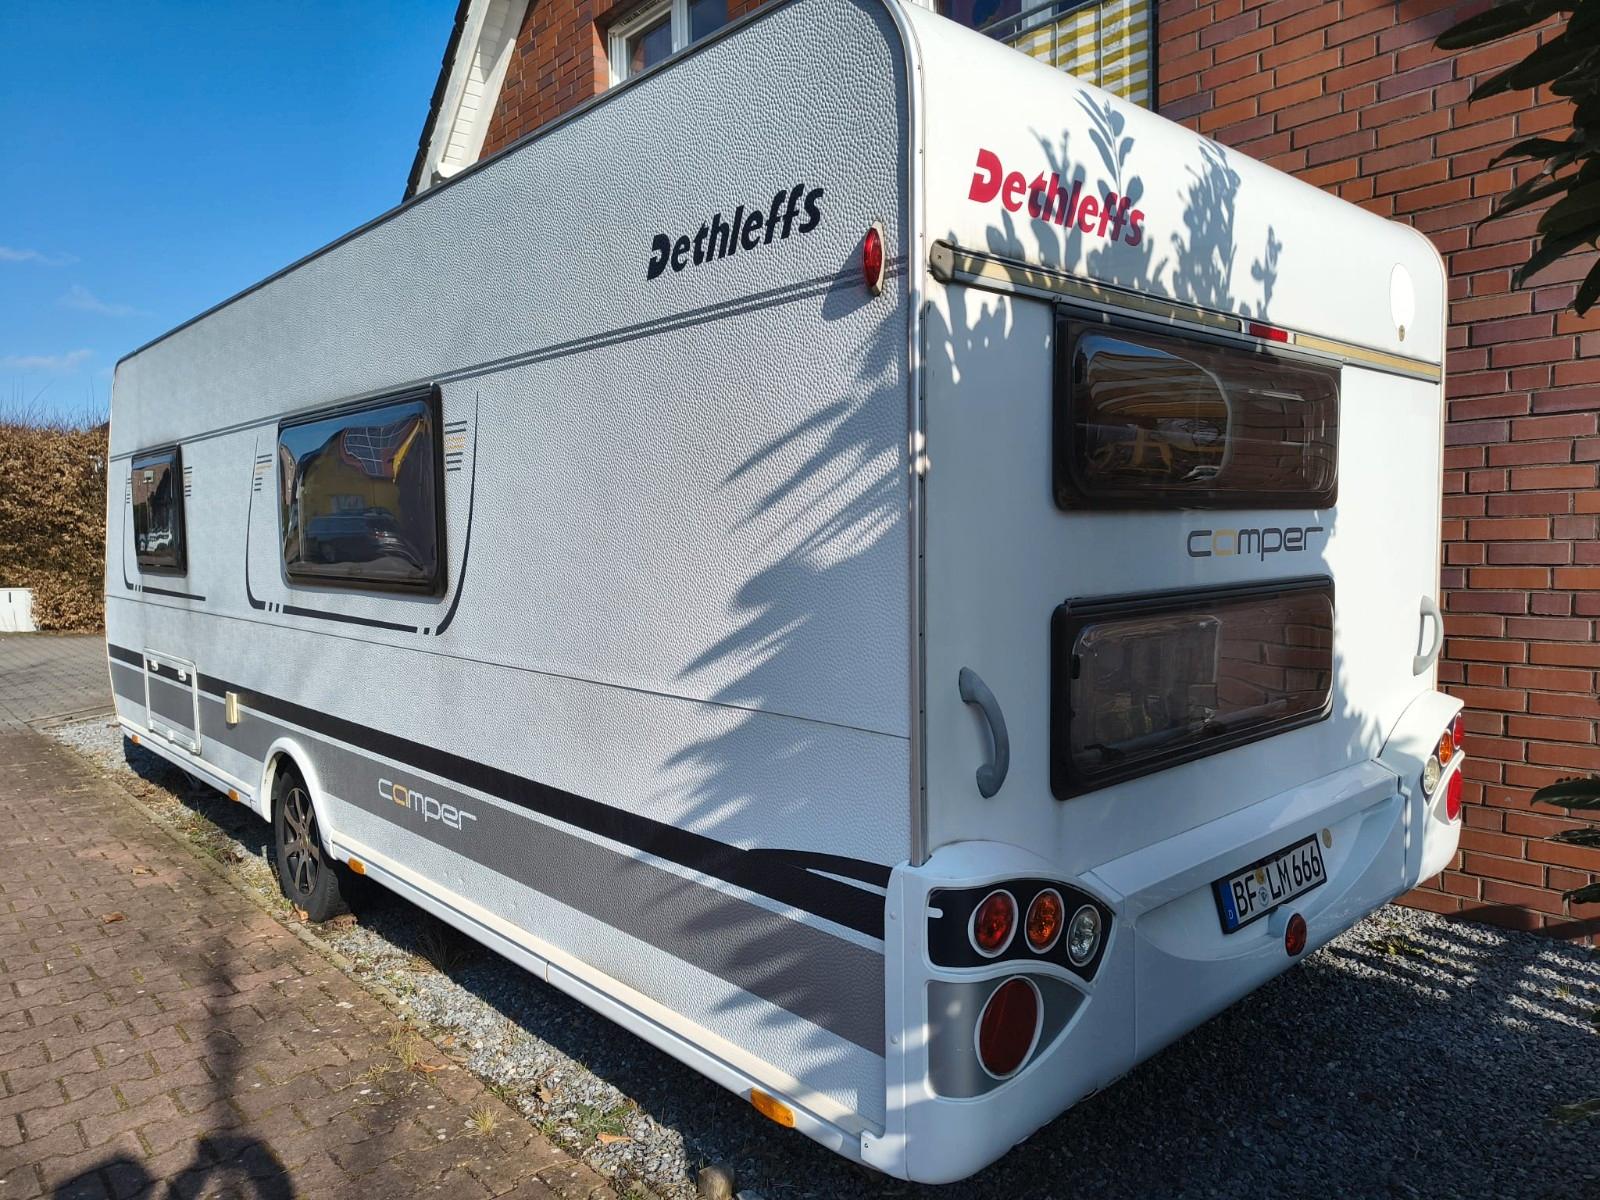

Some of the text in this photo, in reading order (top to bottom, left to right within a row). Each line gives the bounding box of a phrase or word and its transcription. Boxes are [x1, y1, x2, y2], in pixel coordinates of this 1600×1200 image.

[647, 184, 823, 281] Dethleffs
[969, 148, 1145, 247] Dethleffs
[378, 778, 477, 830] camper
[1232, 846, 1321, 917] BF LM 666
